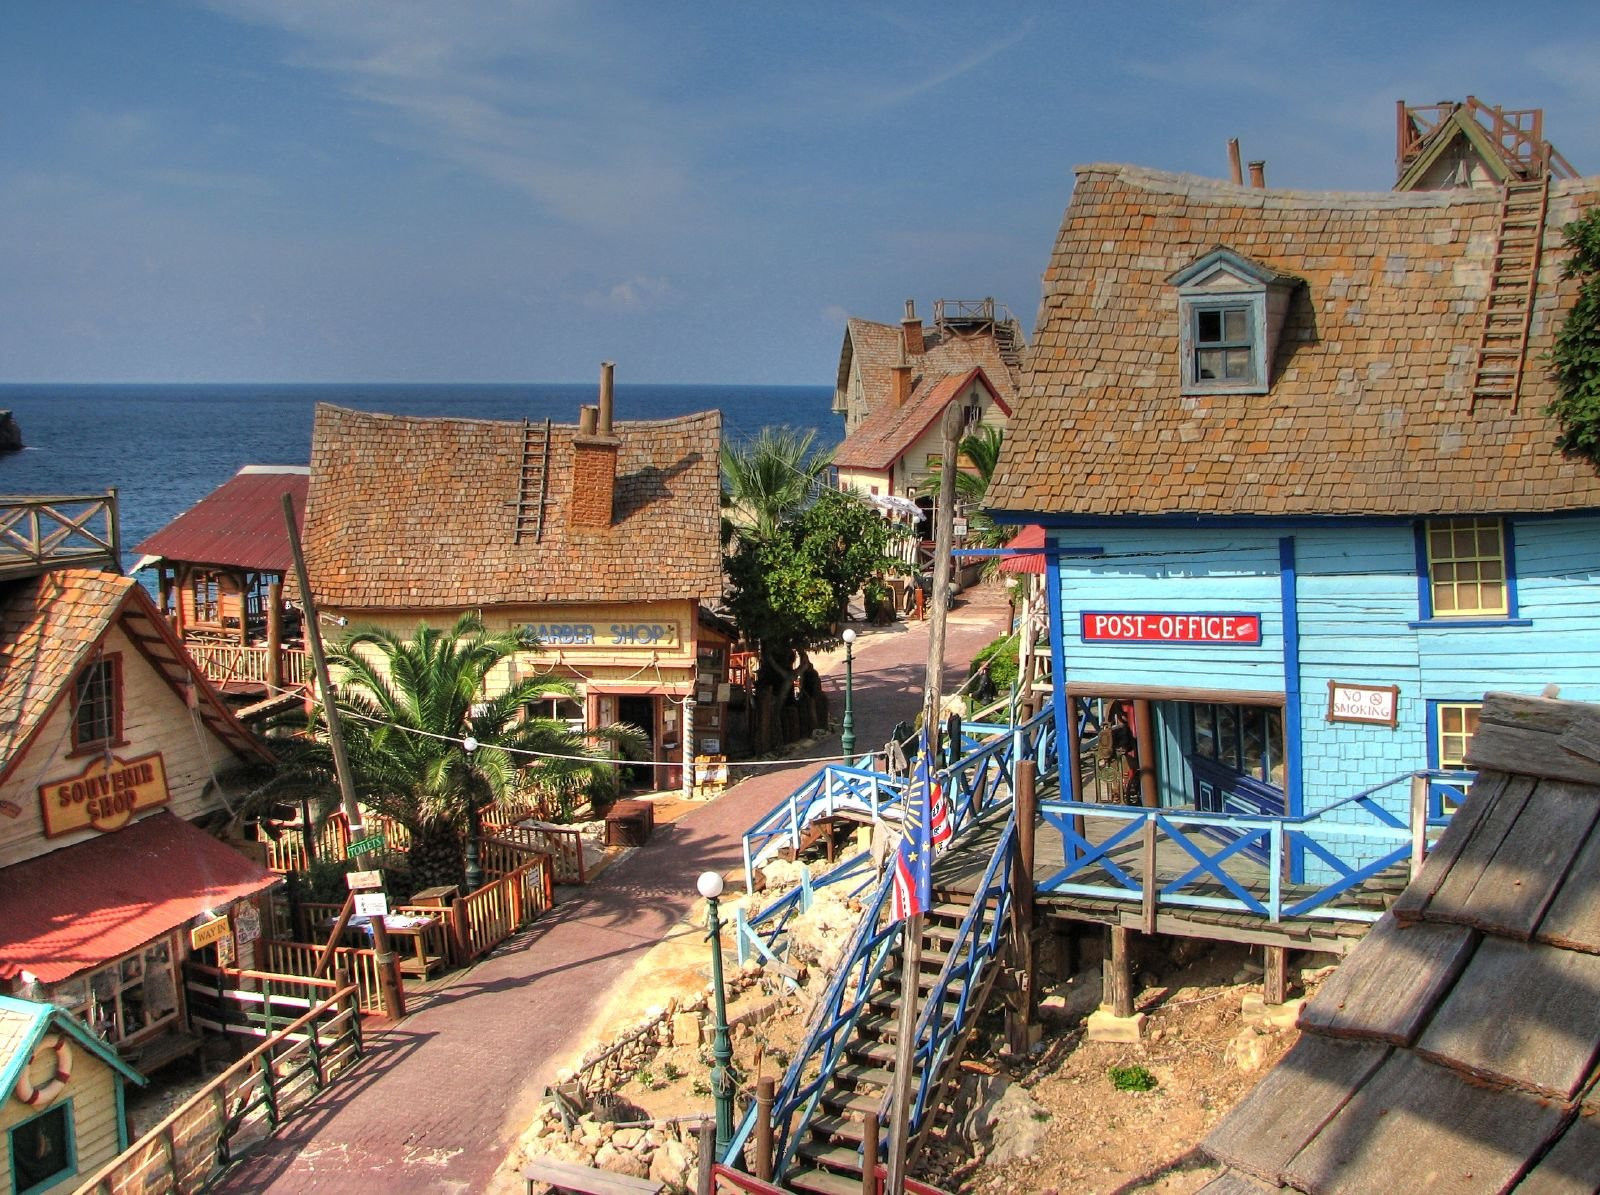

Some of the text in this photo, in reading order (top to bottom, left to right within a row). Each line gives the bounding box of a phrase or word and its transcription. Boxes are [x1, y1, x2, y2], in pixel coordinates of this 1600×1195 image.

[610, 624, 665, 645] SHOP
[1094, 615, 1236, 640] POST-OFFICE
[1342, 690, 1362, 703] NO
[1333, 703, 1390, 718] SMOKING
[58, 763, 155, 807] SOUVENIR
[86, 789, 138, 821] SHOP
[349, 838, 382, 858] TOILETS
[197, 927, 217, 942] WAY
[217, 922, 227, 934] IN
